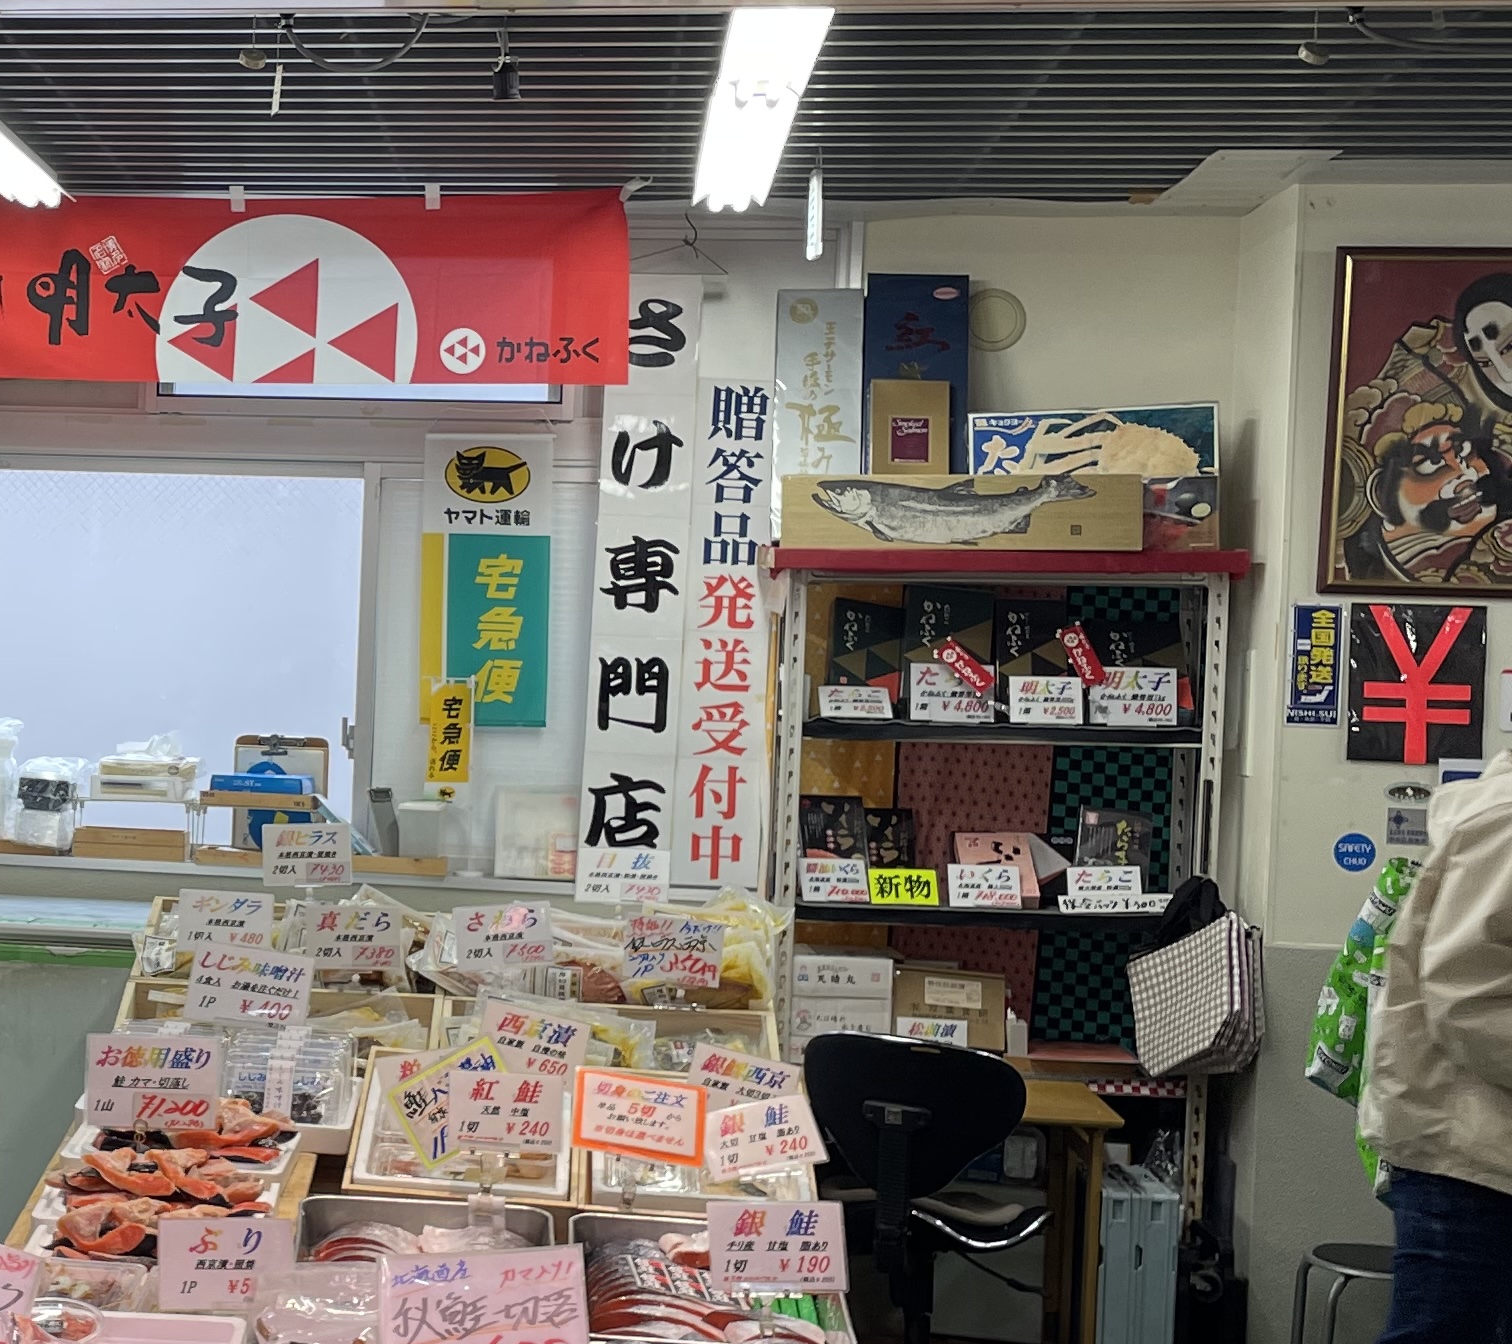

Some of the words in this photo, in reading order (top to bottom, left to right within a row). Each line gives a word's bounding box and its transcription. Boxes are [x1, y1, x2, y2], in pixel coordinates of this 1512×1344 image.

[27, 249, 238, 346] 明太子
[497, 337, 599, 363] かねふく
[444, 508, 530, 526] ヤマト運輸
[472, 554, 523, 704] 宅急便
[689, 386, 770, 881] 贈答品発送受付中
[1309, 609, 1336, 684] 全国発送
[1020, 680, 1072, 695] 明太子
[439, 696, 463, 772] 宅急便
[1338, 842, 1372, 853] SAFETY
[1343, 856, 1367, 866] CHUO
[956, 868, 1012, 882] いくら
[1075, 869, 1133, 884] たらこ
[875, 875, 931, 899] 新物
[192, 896, 263, 914] ギンダラ
[316, 911, 391, 932] 真だら
[200, 951, 306, 984] しじみ味噌汁
[199, 996, 216, 1008] 1P
[497, 1012, 578, 1048] 西京漬
[96, 1045, 211, 1070] お徳用盛り
[469, 1078, 544, 1104] 紅鮭
[93, 1099, 114, 1112] 1山
[627, 1103, 657, 1117] 5切
[666, 1112, 682, 1121] から
[459, 1121, 479, 1133] 1切
[720, 1103, 789, 1137] 銀鮭
[721, 1154, 738, 1166] 1切
[733, 1209, 819, 1238] 銀鮭
[190, 1226, 263, 1254] ぶり
[726, 1241, 755, 1251] チリ産
[766, 1242, 789, 1251] 甘塩
[724, 1259, 748, 1272] 1切
[180, 1280, 198, 1294] 1P
